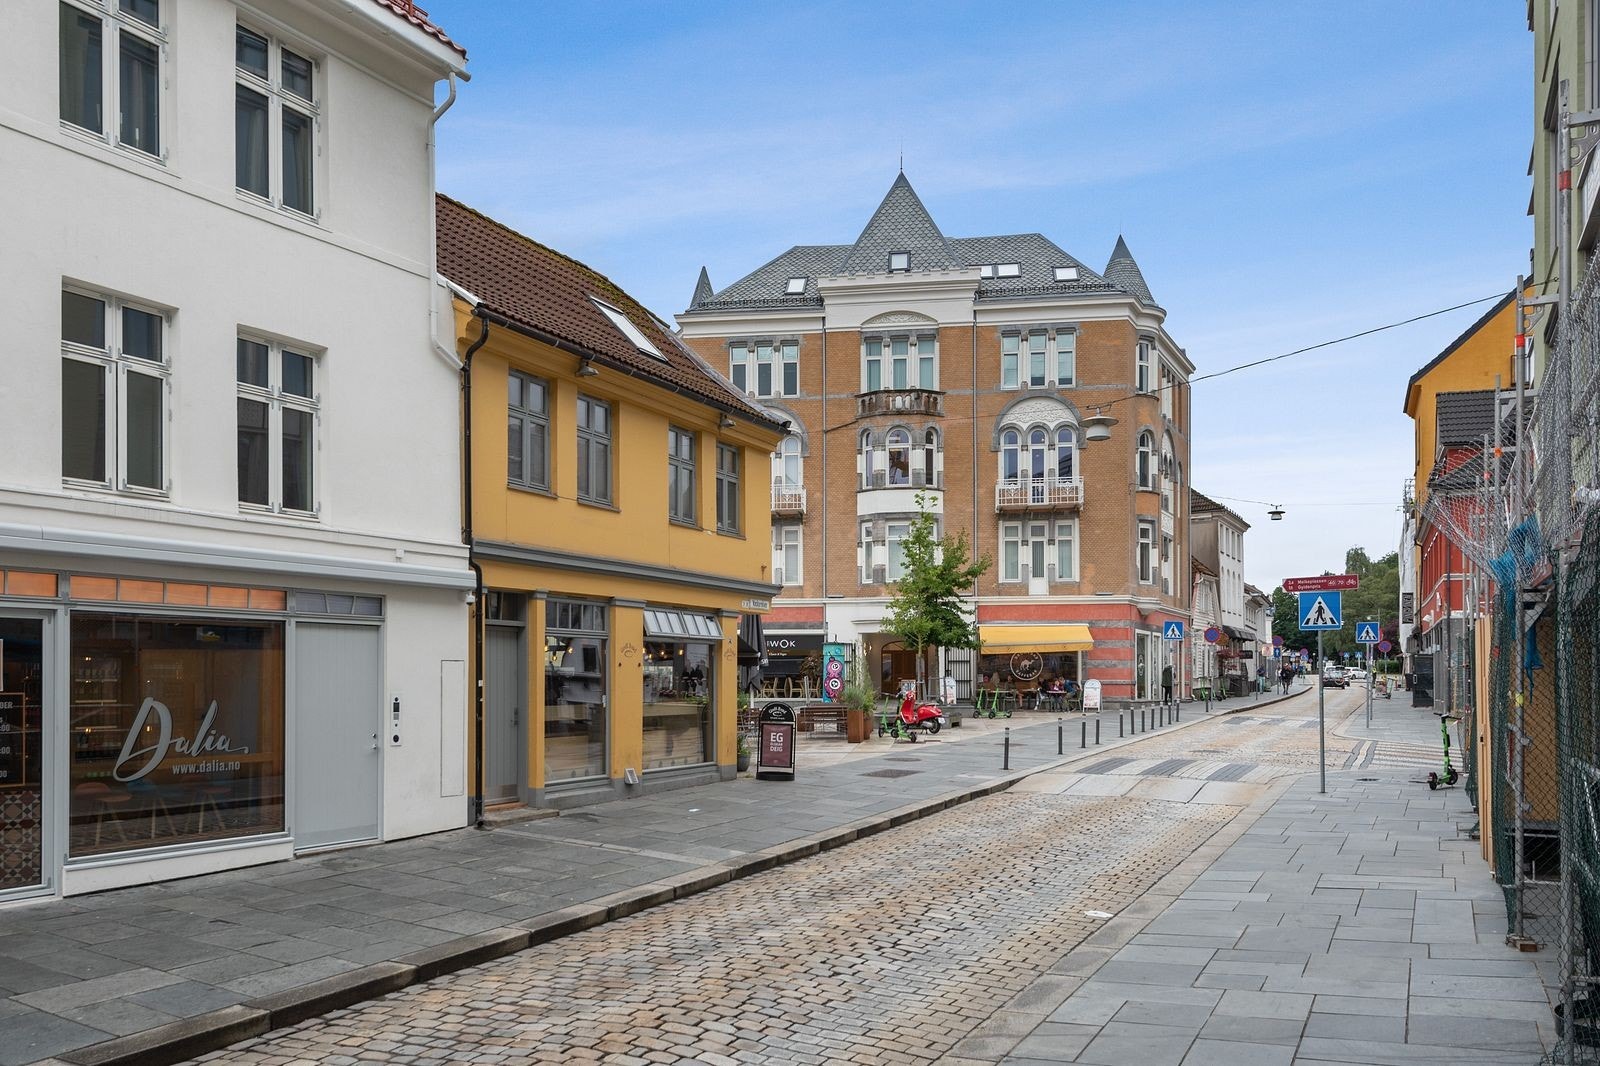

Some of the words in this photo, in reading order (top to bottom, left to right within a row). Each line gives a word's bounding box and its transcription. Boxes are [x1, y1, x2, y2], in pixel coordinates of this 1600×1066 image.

[112, 696, 249, 782] Dalia
[770, 732, 783, 742] EG
[172, 760, 241, 775] www.dalia.no
